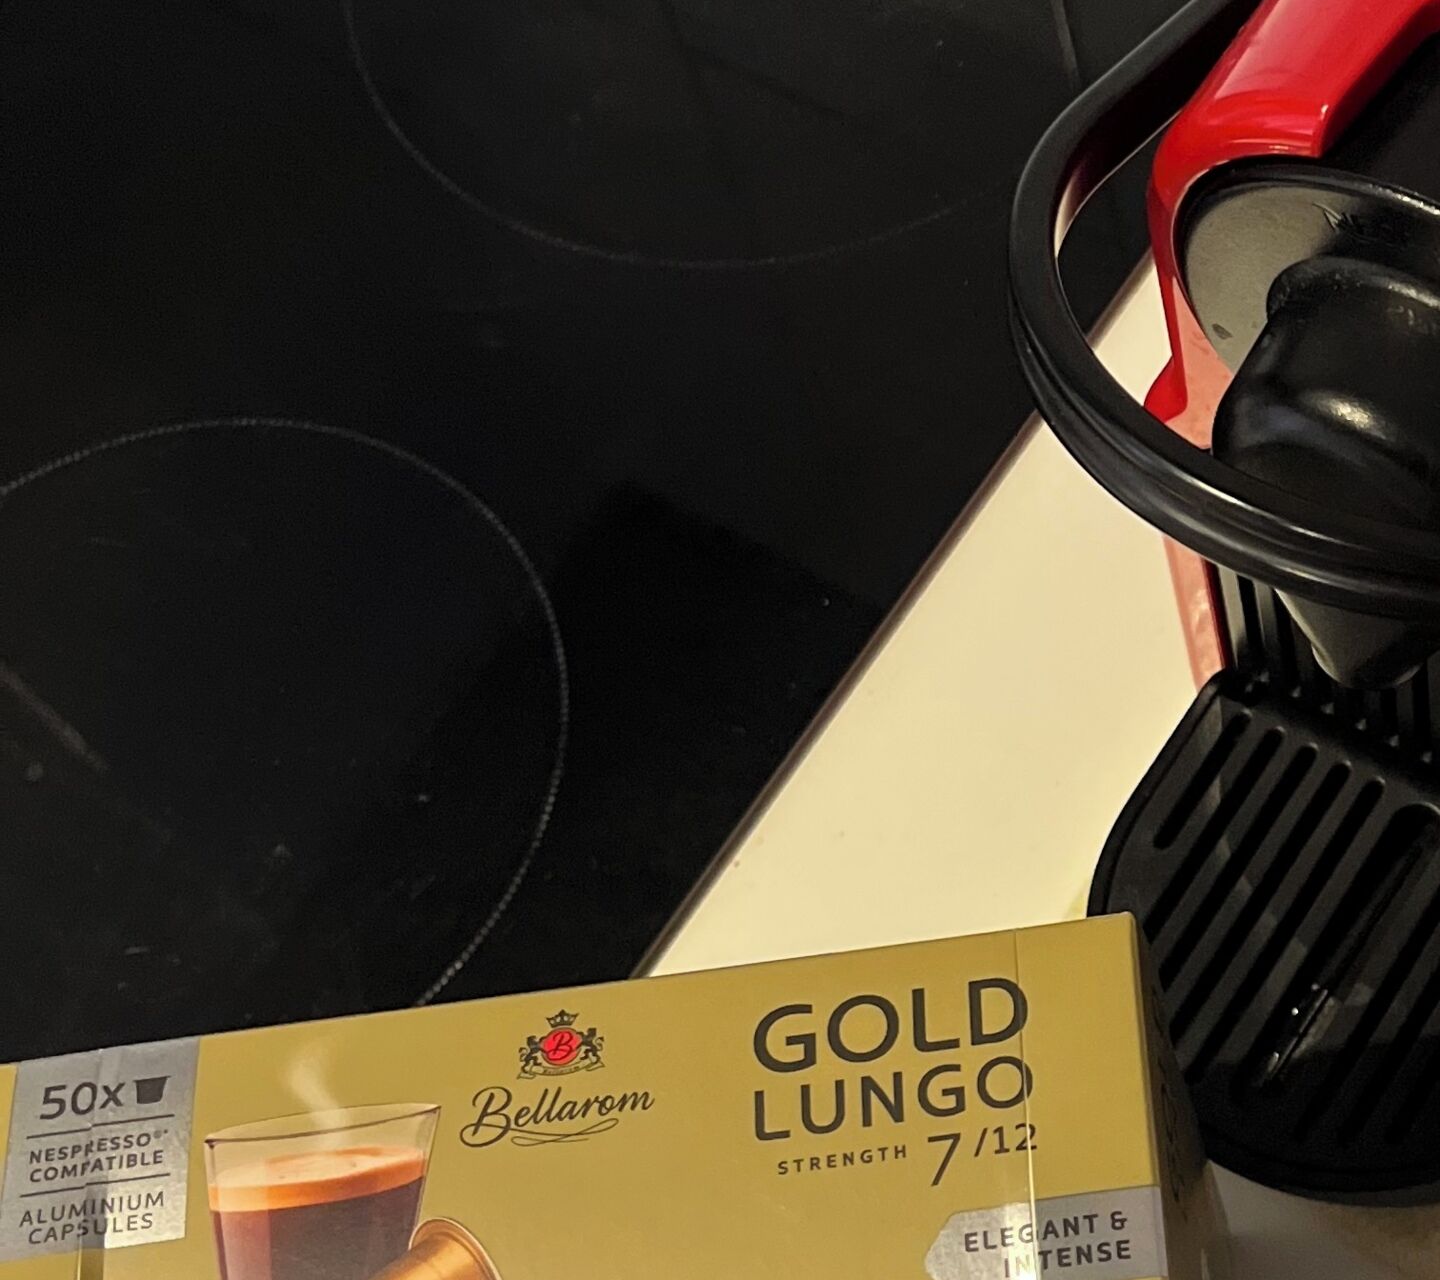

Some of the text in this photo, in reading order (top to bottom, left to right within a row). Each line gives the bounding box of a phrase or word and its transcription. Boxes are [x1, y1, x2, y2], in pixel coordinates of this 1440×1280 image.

[753, 977, 1028, 1073] GOLD
[459, 1086, 655, 1148] Bellarom
[754, 1055, 1033, 1141] LUNGO
[30, 1150, 164, 1183] COMPATIBLE
[777, 1144, 907, 1175] STRENGTH
[19, 1191, 164, 1228] ALUMINIUM
[29, 1213, 153, 1244] CAPSULES
[964, 1210, 1129, 1253] ELEGANT &
[1004, 1239, 1131, 1279] INTENSE
